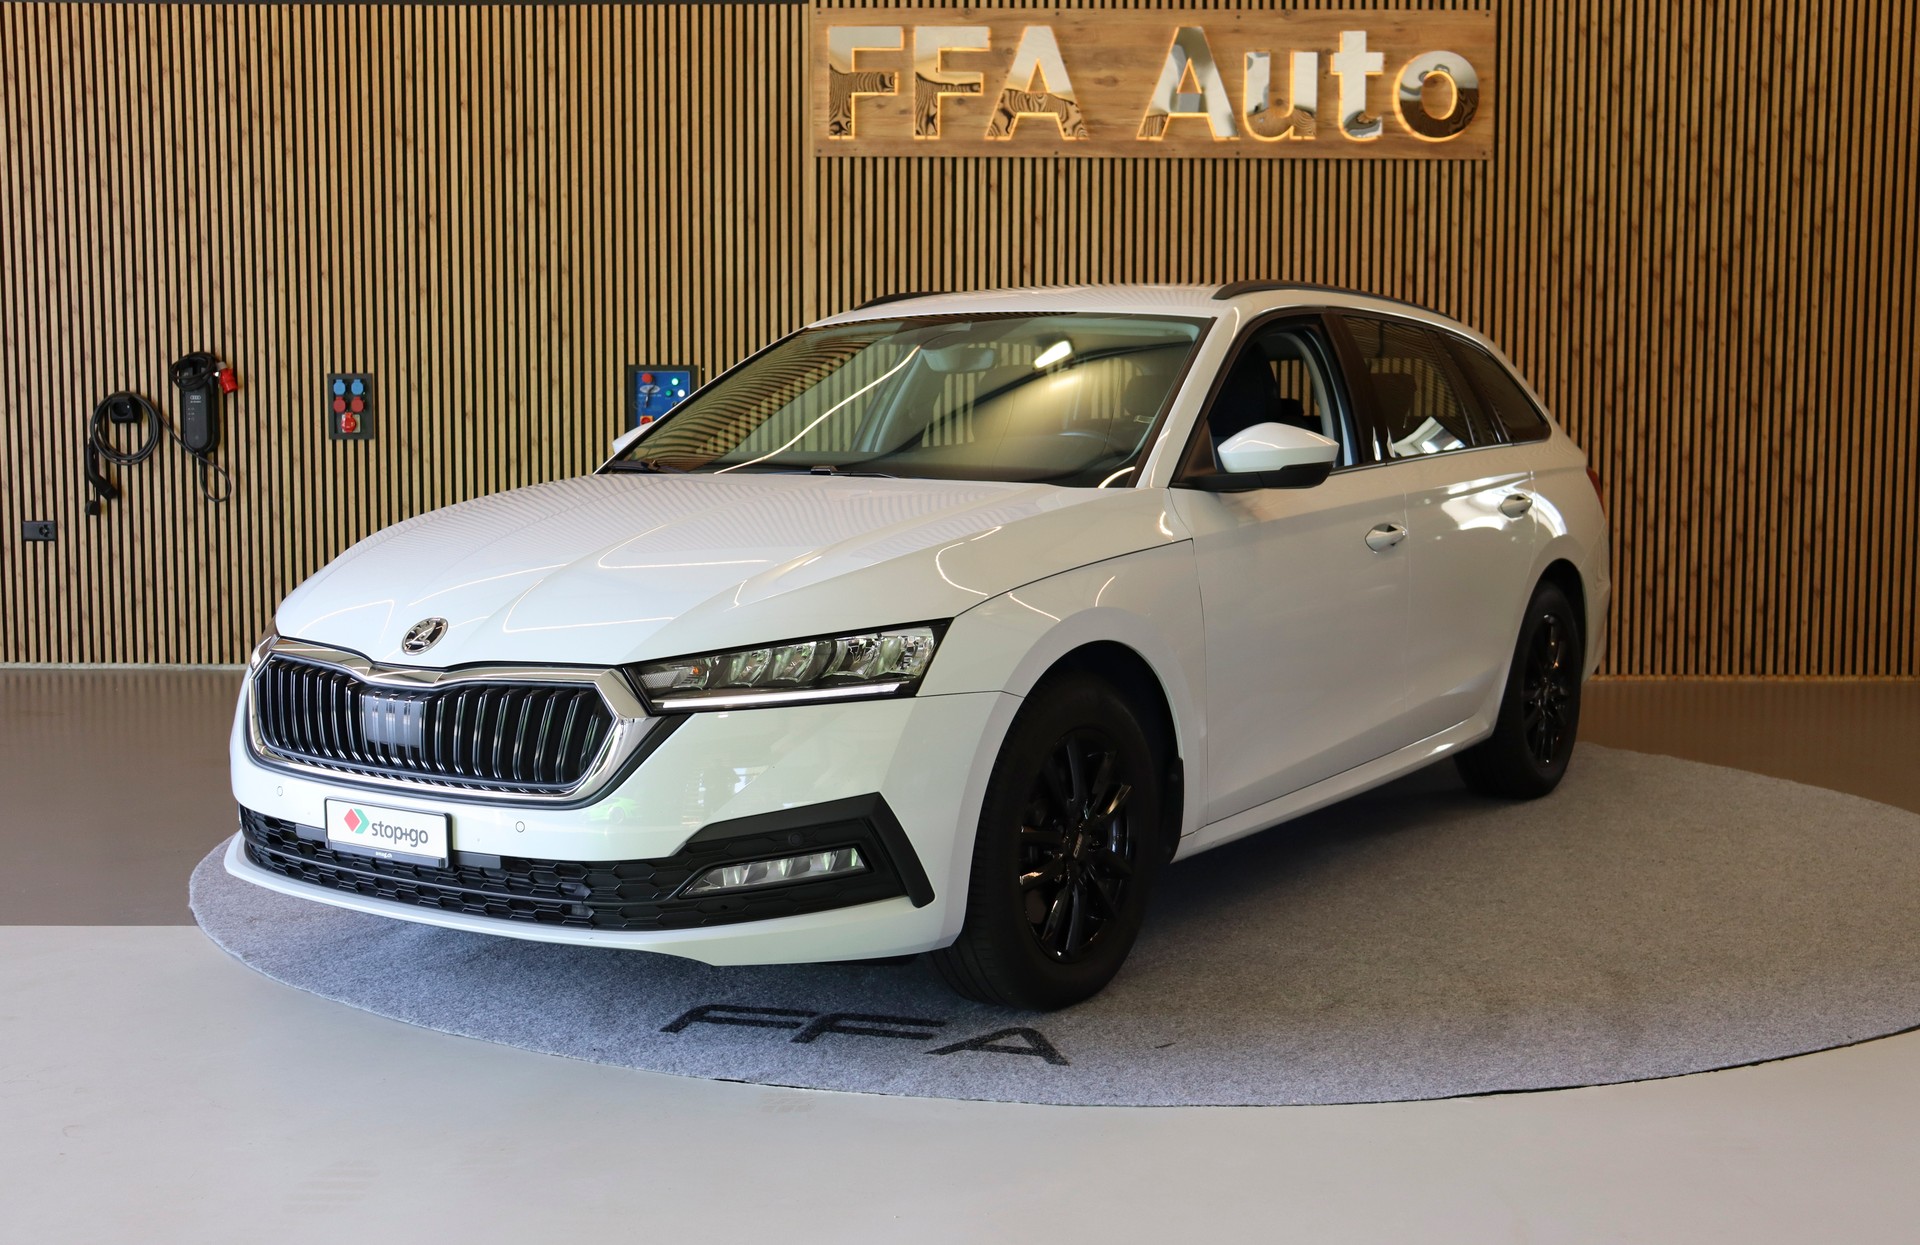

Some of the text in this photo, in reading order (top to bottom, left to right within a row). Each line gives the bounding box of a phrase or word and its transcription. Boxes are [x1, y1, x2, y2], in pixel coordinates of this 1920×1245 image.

[827, 25, 1480, 142] FFA Auto
[371, 821, 429, 847] stop+go
[659, 1004, 1070, 1066] FFA
